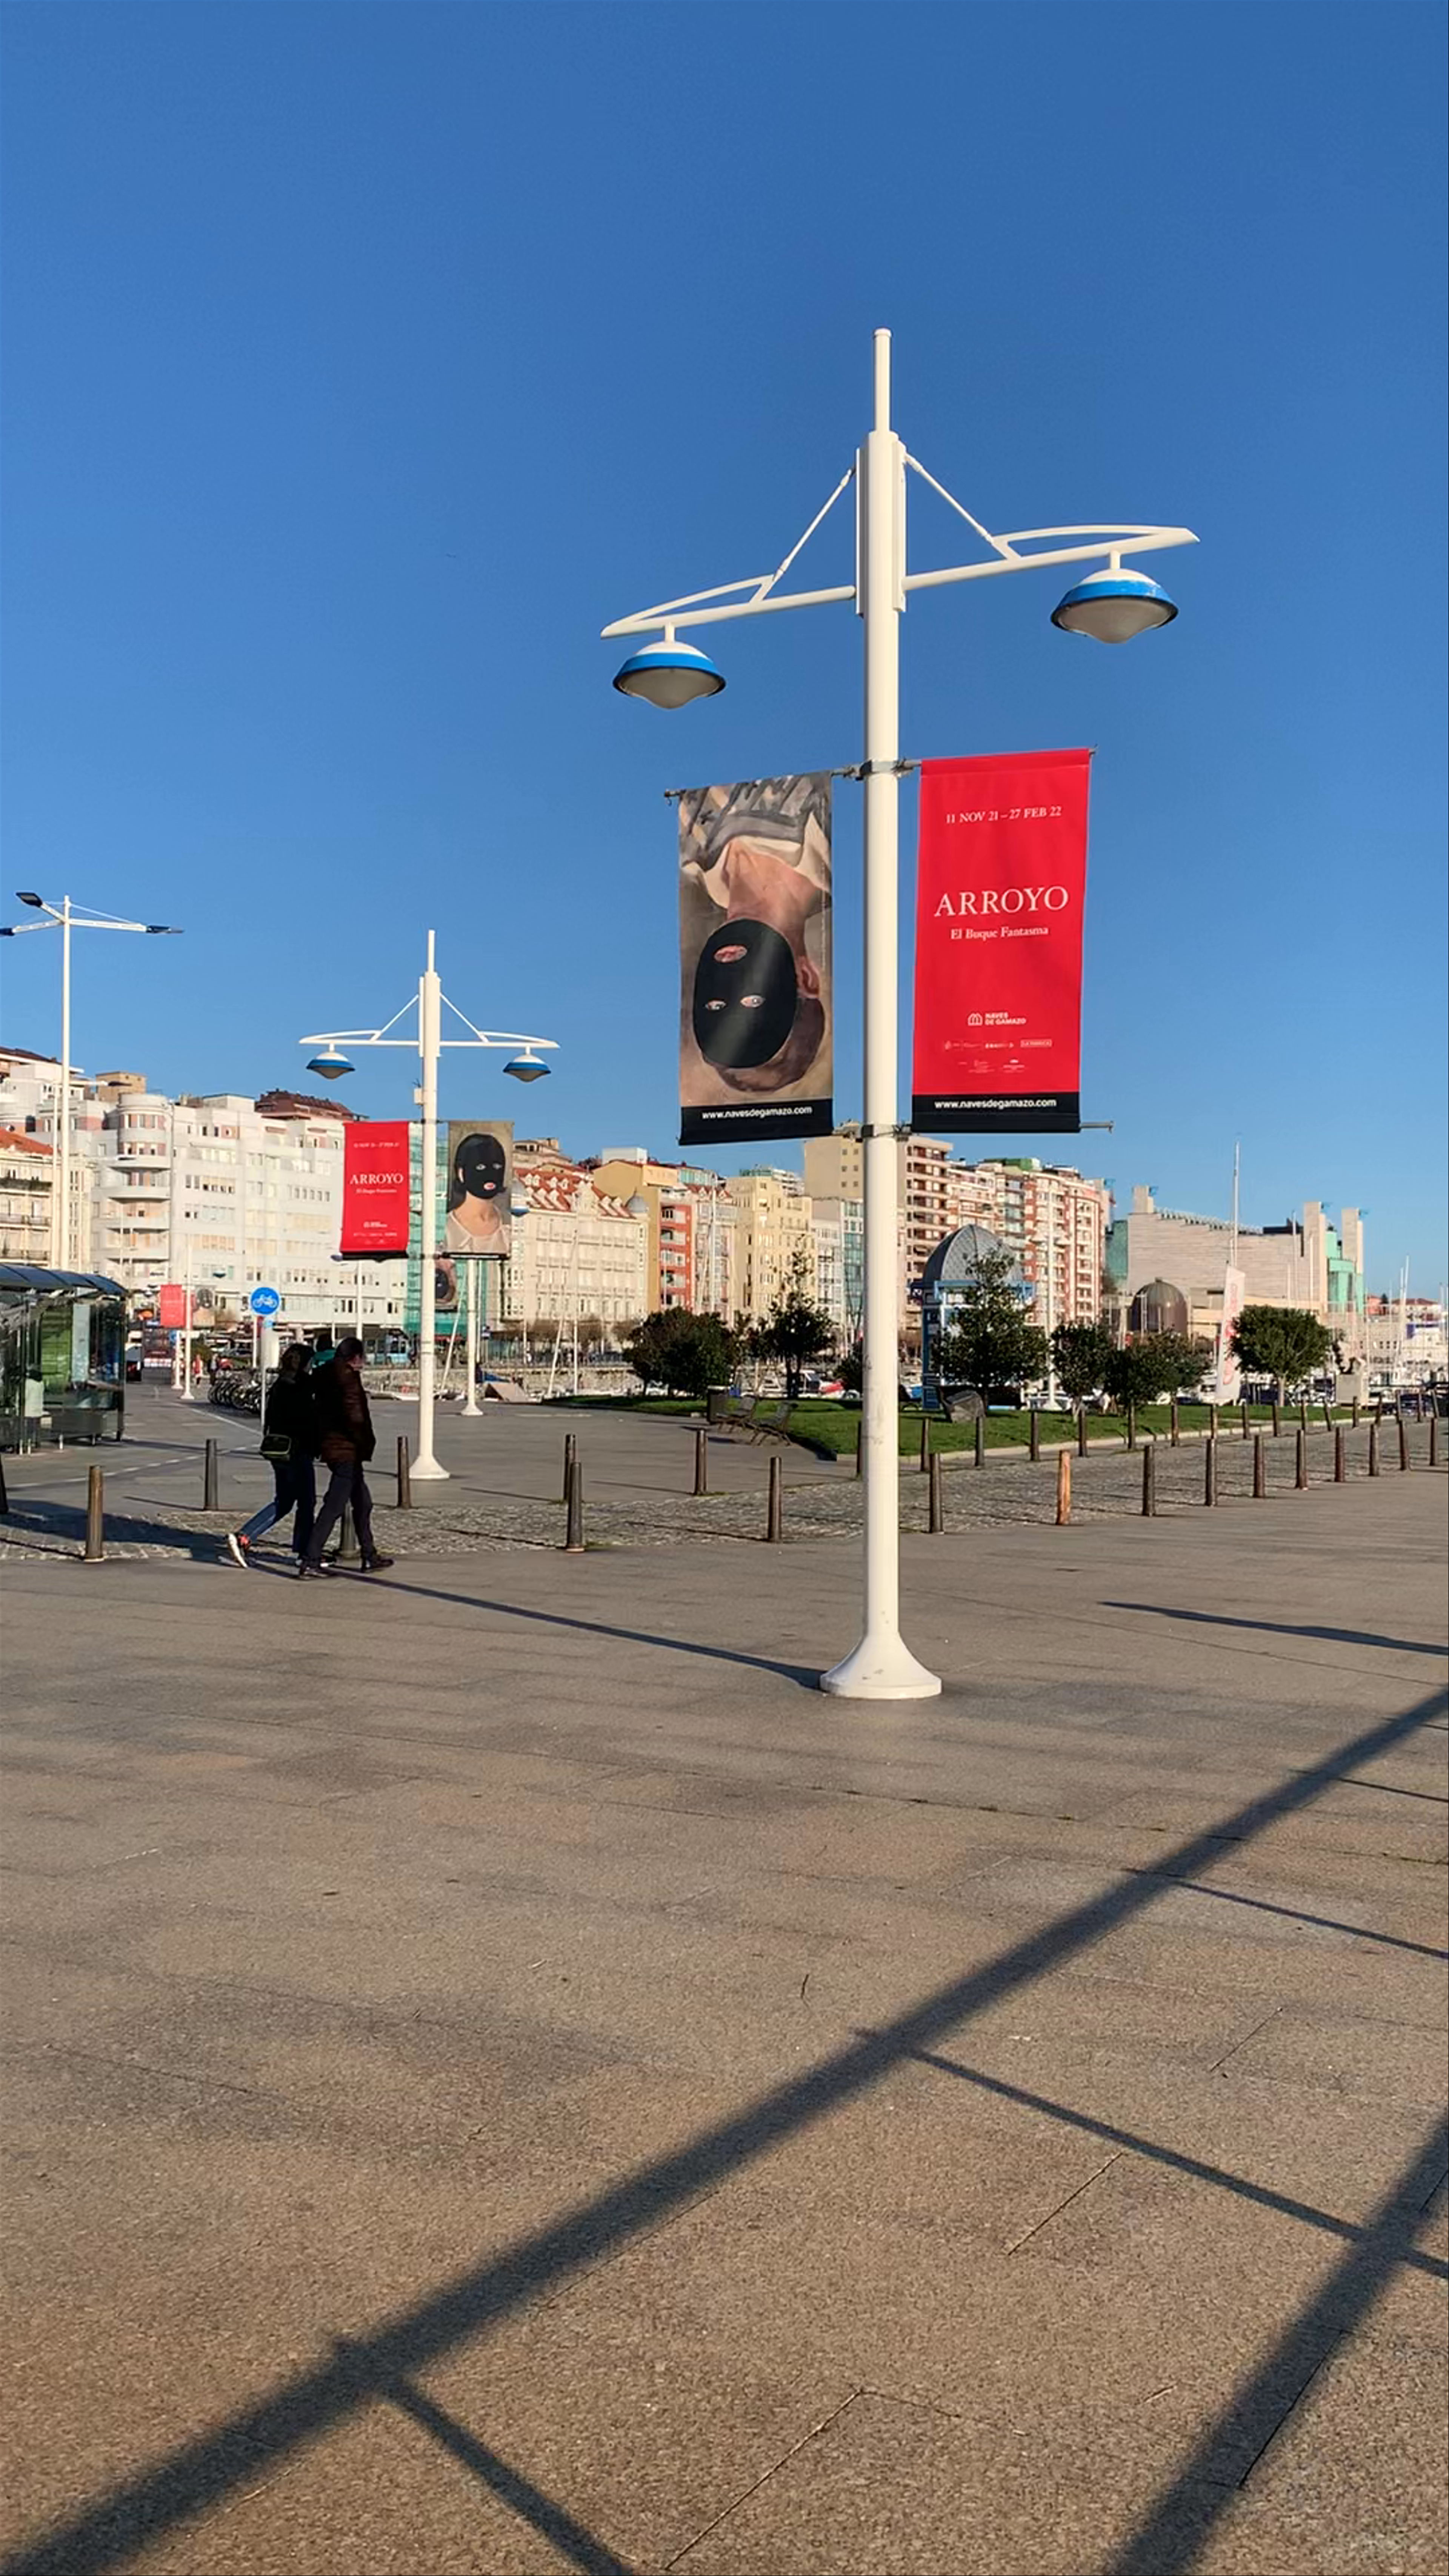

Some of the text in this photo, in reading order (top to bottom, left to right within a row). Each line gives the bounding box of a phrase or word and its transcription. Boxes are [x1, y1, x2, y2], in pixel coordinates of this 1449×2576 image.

[946, 814, 955, 824] 11
[960, 811, 985, 823] NOV
[989, 810, 998, 821] 21
[1009, 809, 1021, 819] 27
[1024, 807, 1047, 818] FEB
[1050, 806, 1061, 817] 22
[934, 886, 1069, 917] ARROYO
[951, 926, 1049, 941] El Buque Fantasma
[934, 1098, 1057, 1110] www.navesdegamazo.com
[702, 1105, 812, 1120] www.navesdegamazo.com
[349, 1173, 404, 1185] ARROYO
